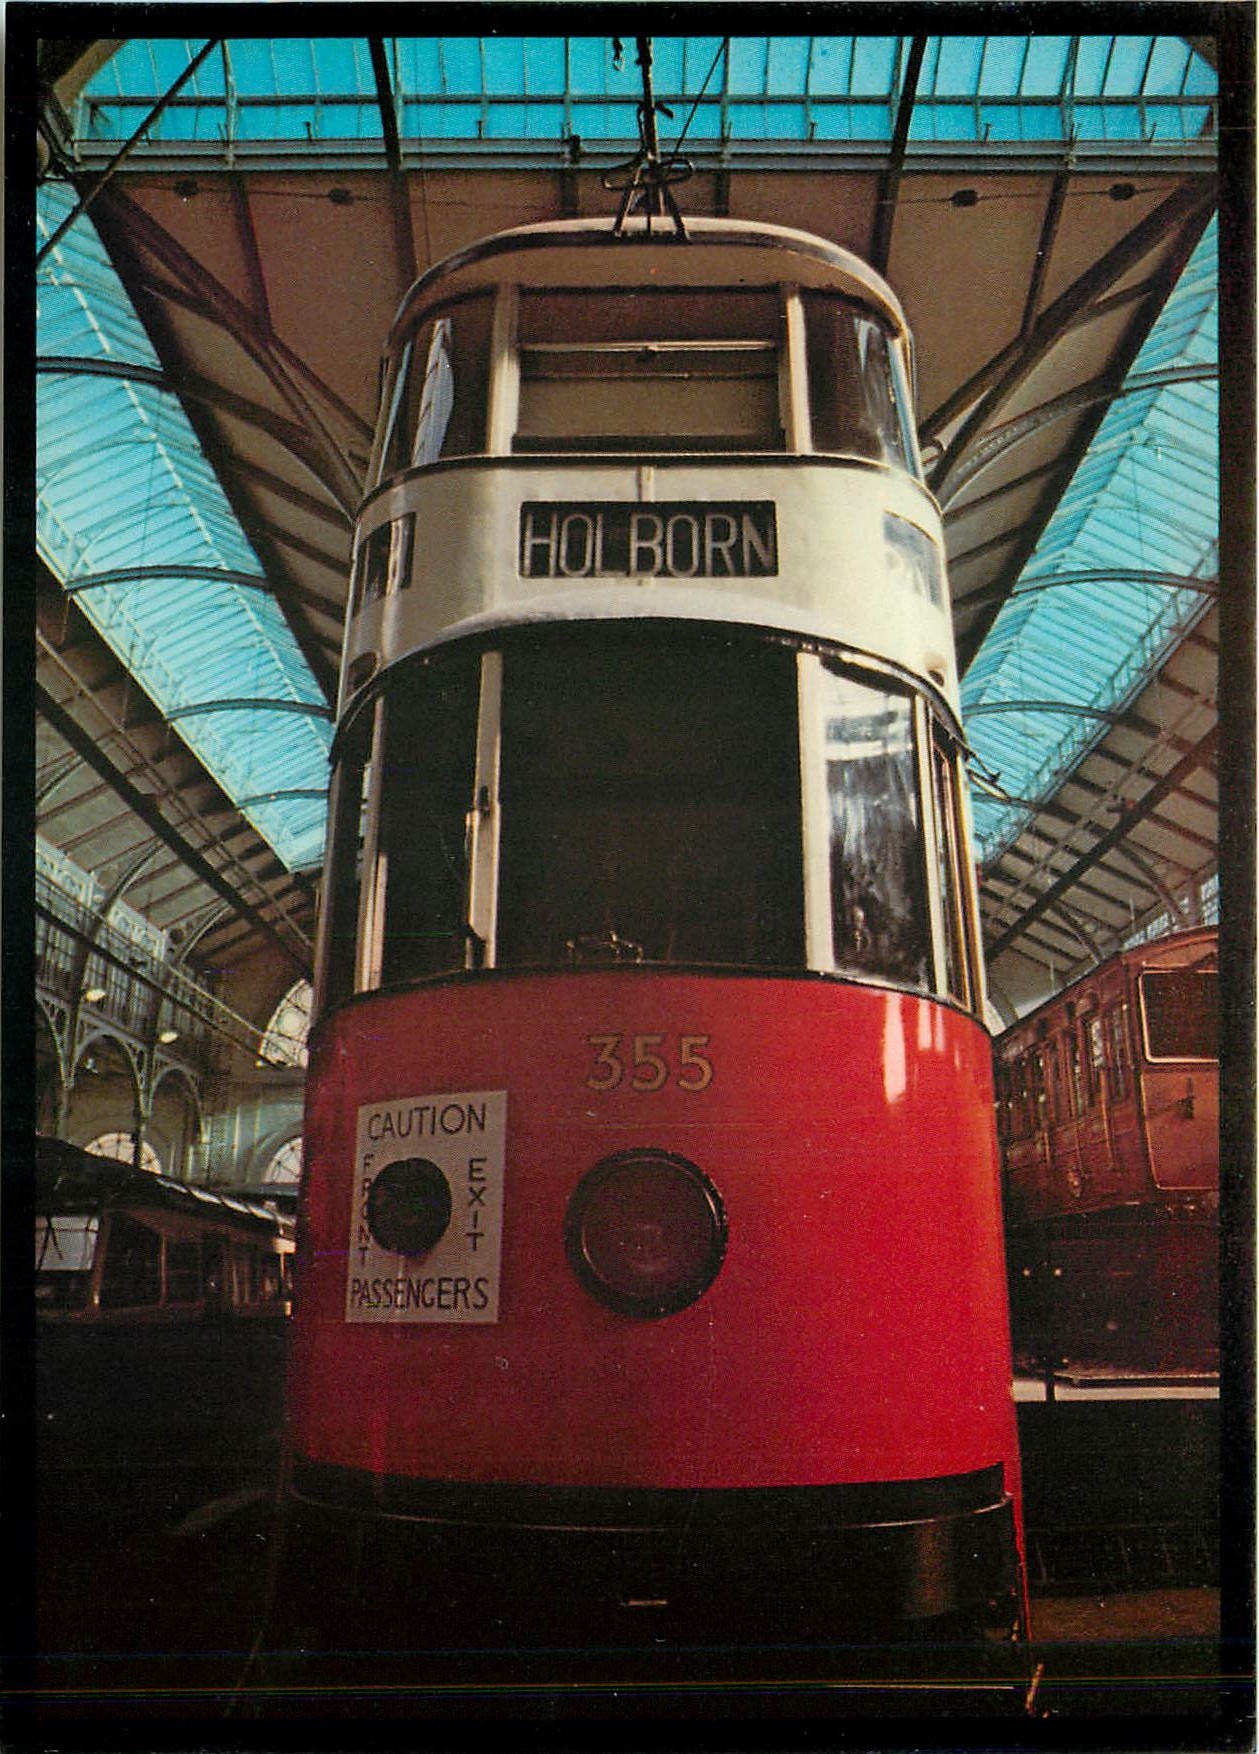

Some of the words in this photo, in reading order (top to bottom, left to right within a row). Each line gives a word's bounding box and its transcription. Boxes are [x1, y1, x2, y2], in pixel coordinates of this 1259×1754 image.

[523, 512, 777, 577] HOLBORN
[585, 1033, 714, 1092] 355
[367, 1103, 488, 1141] CAUTION
[465, 1158, 488, 1252] EXIT
[350, 1277, 490, 1311] PASSENGERS
